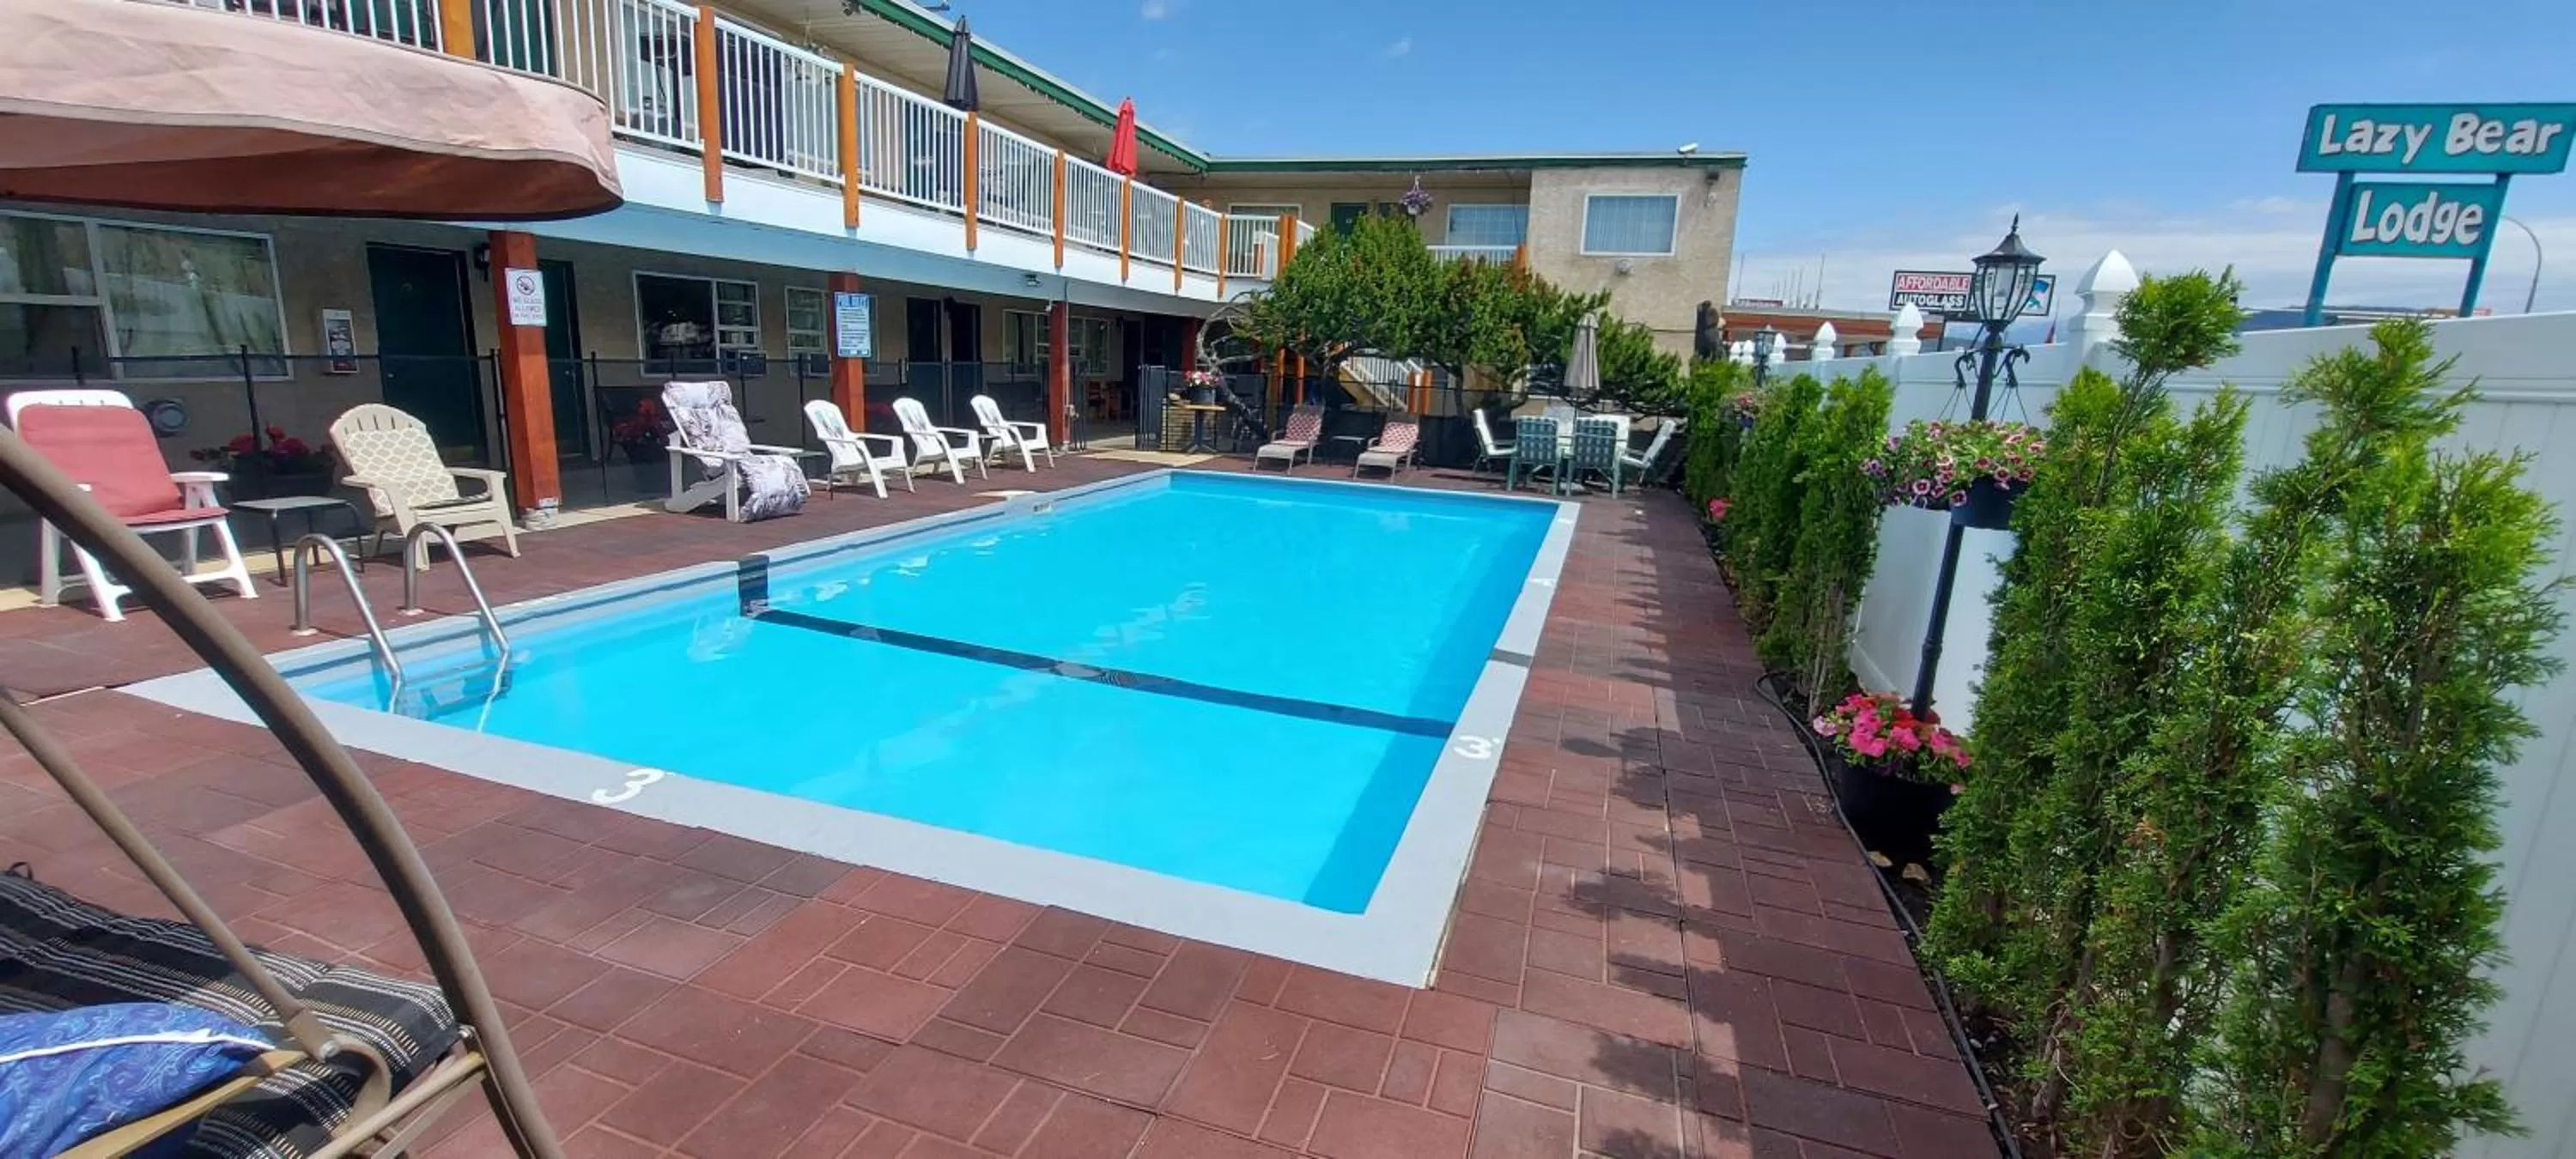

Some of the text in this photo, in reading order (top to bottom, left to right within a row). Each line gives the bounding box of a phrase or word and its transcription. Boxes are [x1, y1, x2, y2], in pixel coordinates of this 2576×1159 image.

[2318, 112, 2563, 165] Lazy Bear
[2350, 190, 2483, 246] Lodge
[1897, 274, 1971, 290] AFFORDABLE
[1896, 294, 1964, 306] AUTOGLASS
